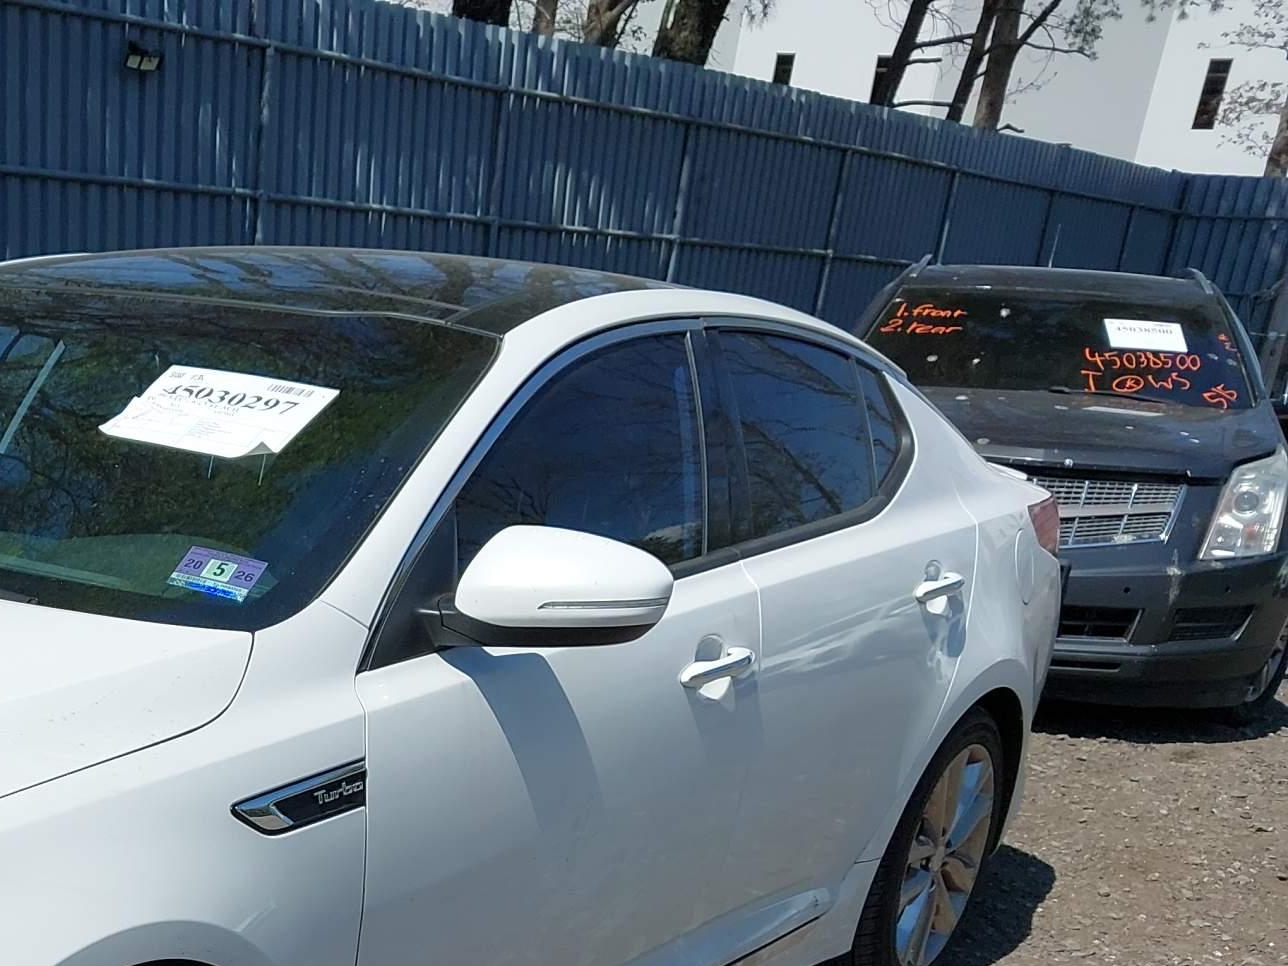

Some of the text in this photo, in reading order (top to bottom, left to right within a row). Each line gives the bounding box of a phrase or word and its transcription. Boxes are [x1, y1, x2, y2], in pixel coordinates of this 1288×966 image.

[1085, 347, 1201, 371] 45038500
[162, 384, 300, 415] 45030297
[184, 558, 203, 570] 20
[212, 562, 229, 577] 5
[234, 570, 255, 583] 26
[313, 780, 364, 805] Turbo
